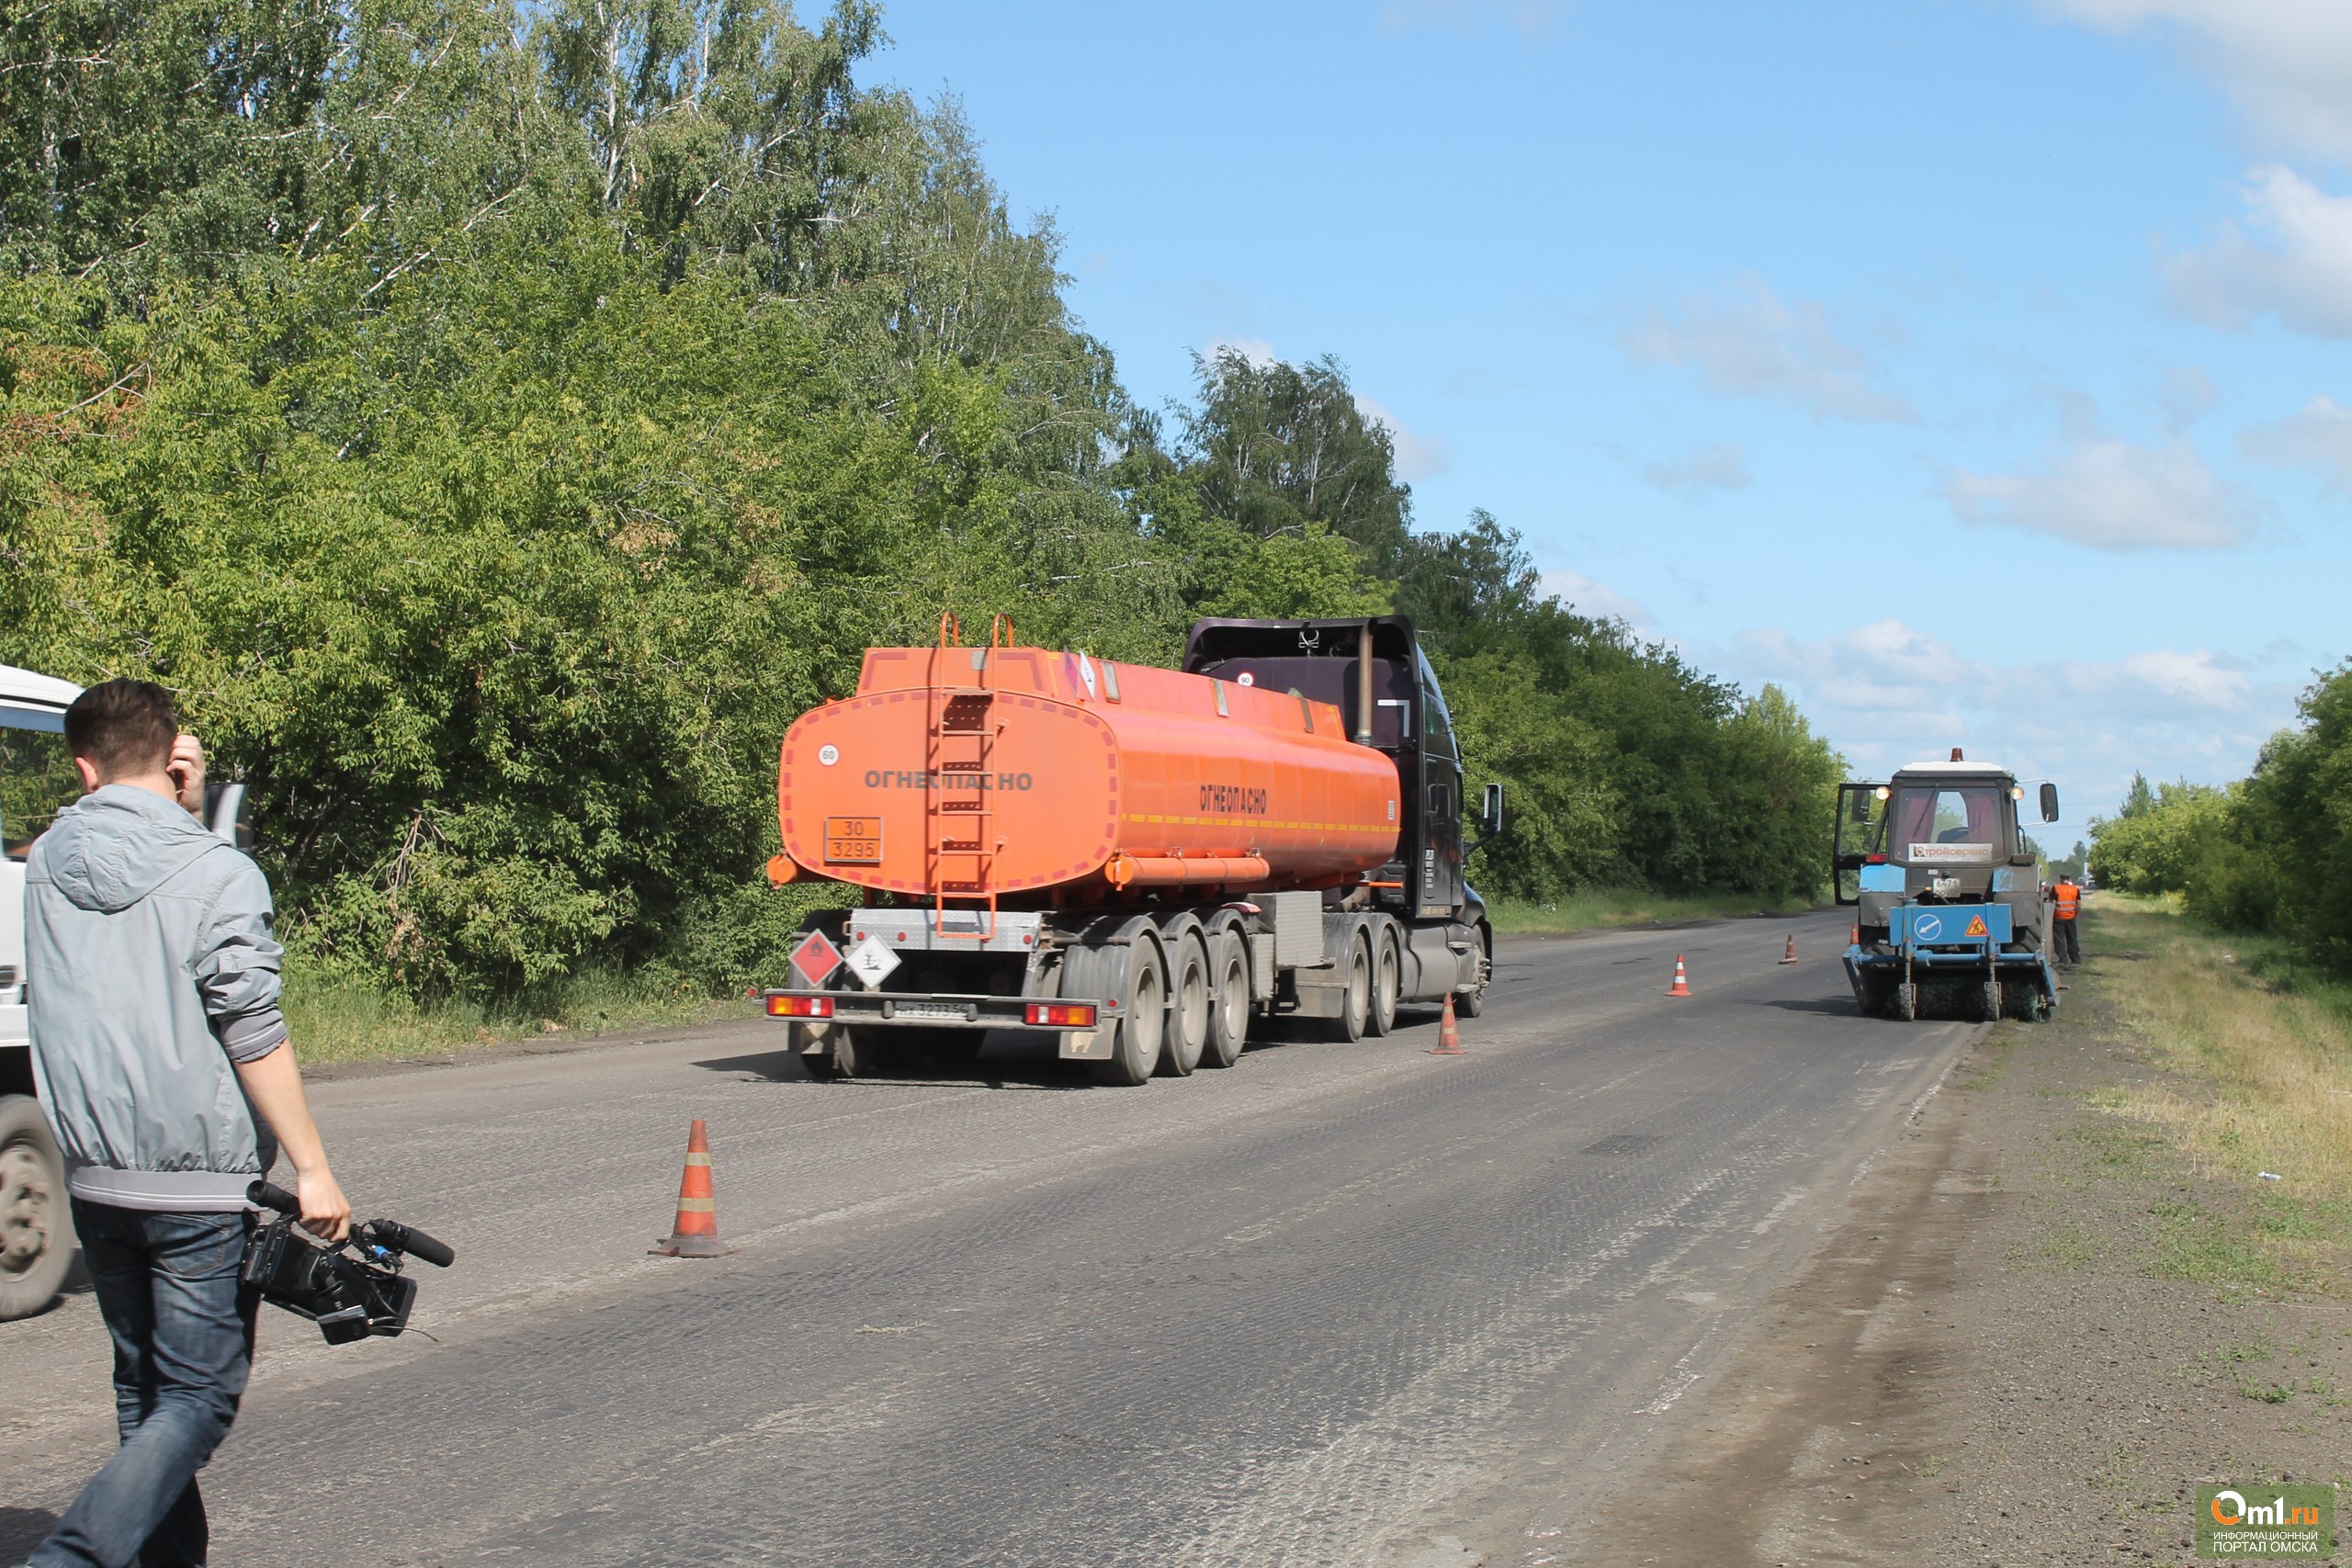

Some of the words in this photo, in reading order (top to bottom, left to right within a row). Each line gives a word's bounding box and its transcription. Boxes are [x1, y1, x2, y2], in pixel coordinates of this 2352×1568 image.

[821, 750, 836, 761] 60
[1200, 784, 1267, 815] ОГНЕОПАСНО
[843, 820, 864, 836] 30
[833, 841, 875, 857] 3295
